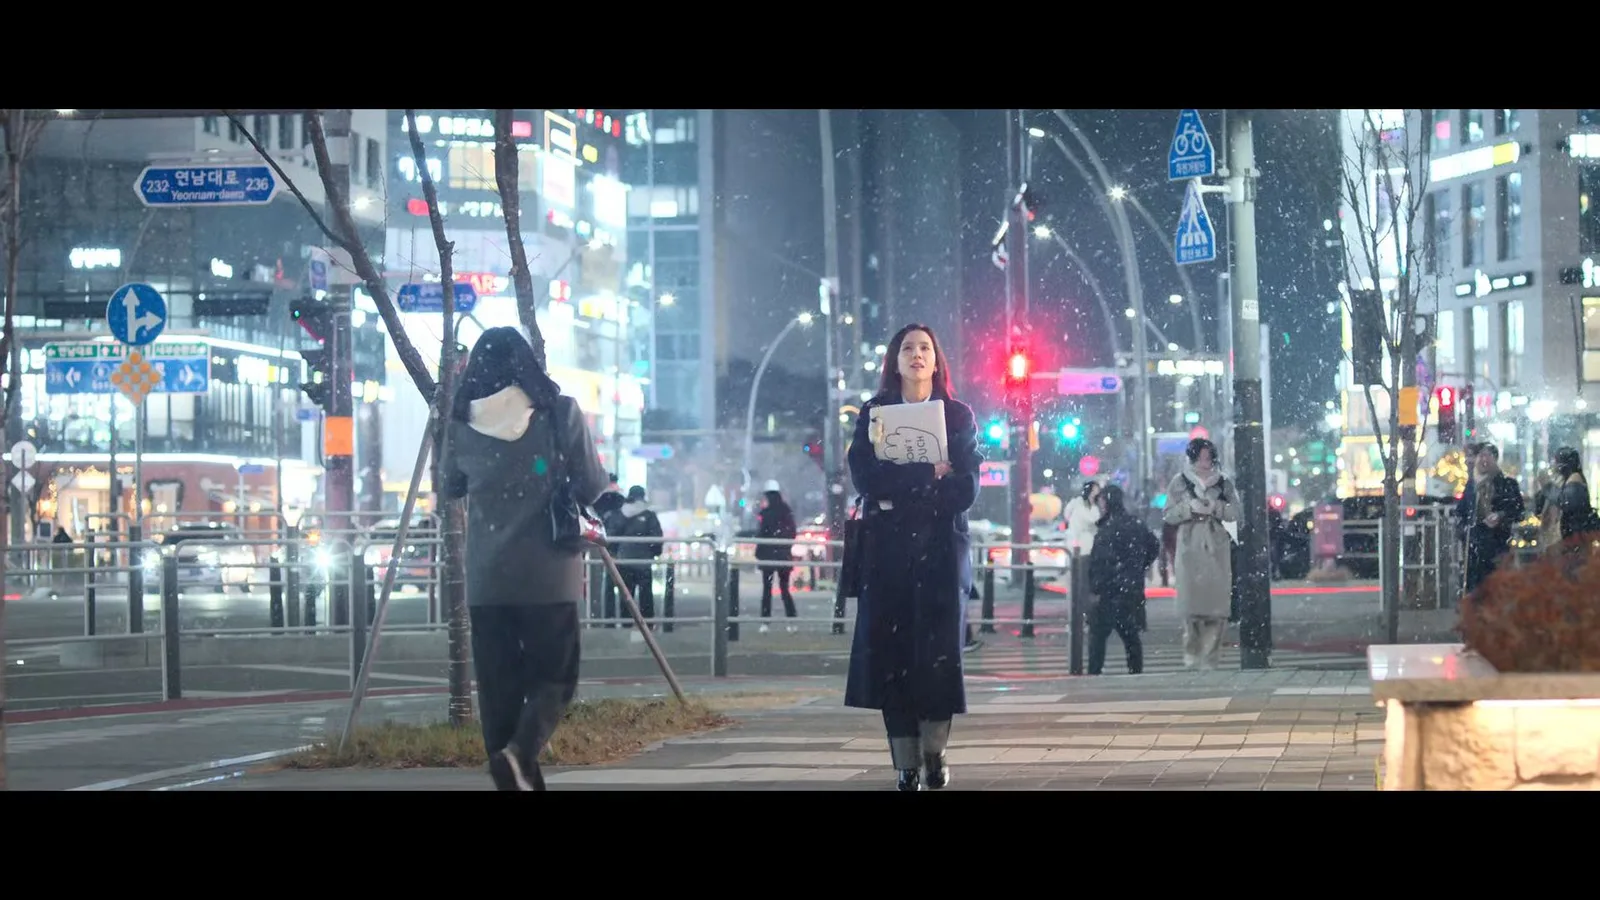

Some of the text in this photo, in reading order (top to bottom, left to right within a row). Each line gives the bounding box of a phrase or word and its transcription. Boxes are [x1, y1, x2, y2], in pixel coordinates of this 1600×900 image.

[147, 170, 269, 194] 232 연남대로 236
[905, 440, 914, 462] ON'T
[917, 436, 929, 462] OUCH
